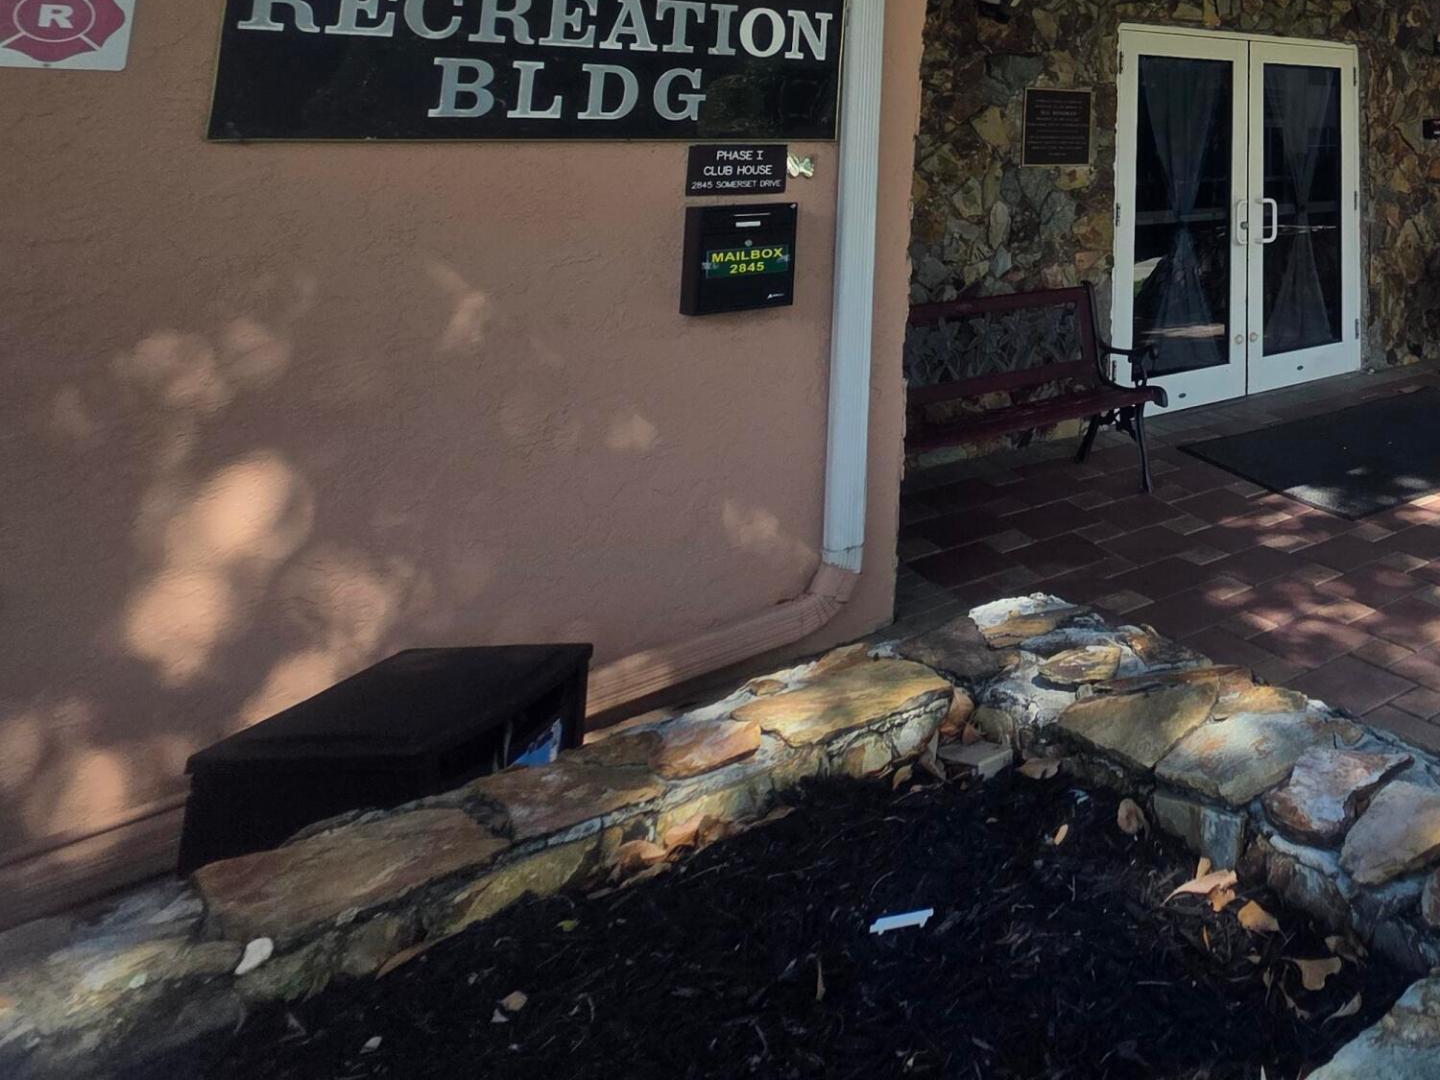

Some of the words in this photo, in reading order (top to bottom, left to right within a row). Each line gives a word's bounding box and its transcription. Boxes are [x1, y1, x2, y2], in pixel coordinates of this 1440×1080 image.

[38, 3, 74, 29] R
[427, 57, 707, 121] BLDG
[716, 150, 754, 161] PHASE
[756, 150, 764, 160] I
[703, 165, 733, 177] CLUB
[736, 164, 773, 176] HOUSE
[690, 180, 714, 190] 2845
[715, 180, 757, 189] SOMERSET
[759, 179, 782, 188] DRIVE
[711, 247, 784, 263] MAILBOX
[729, 261, 765, 274] 2845
